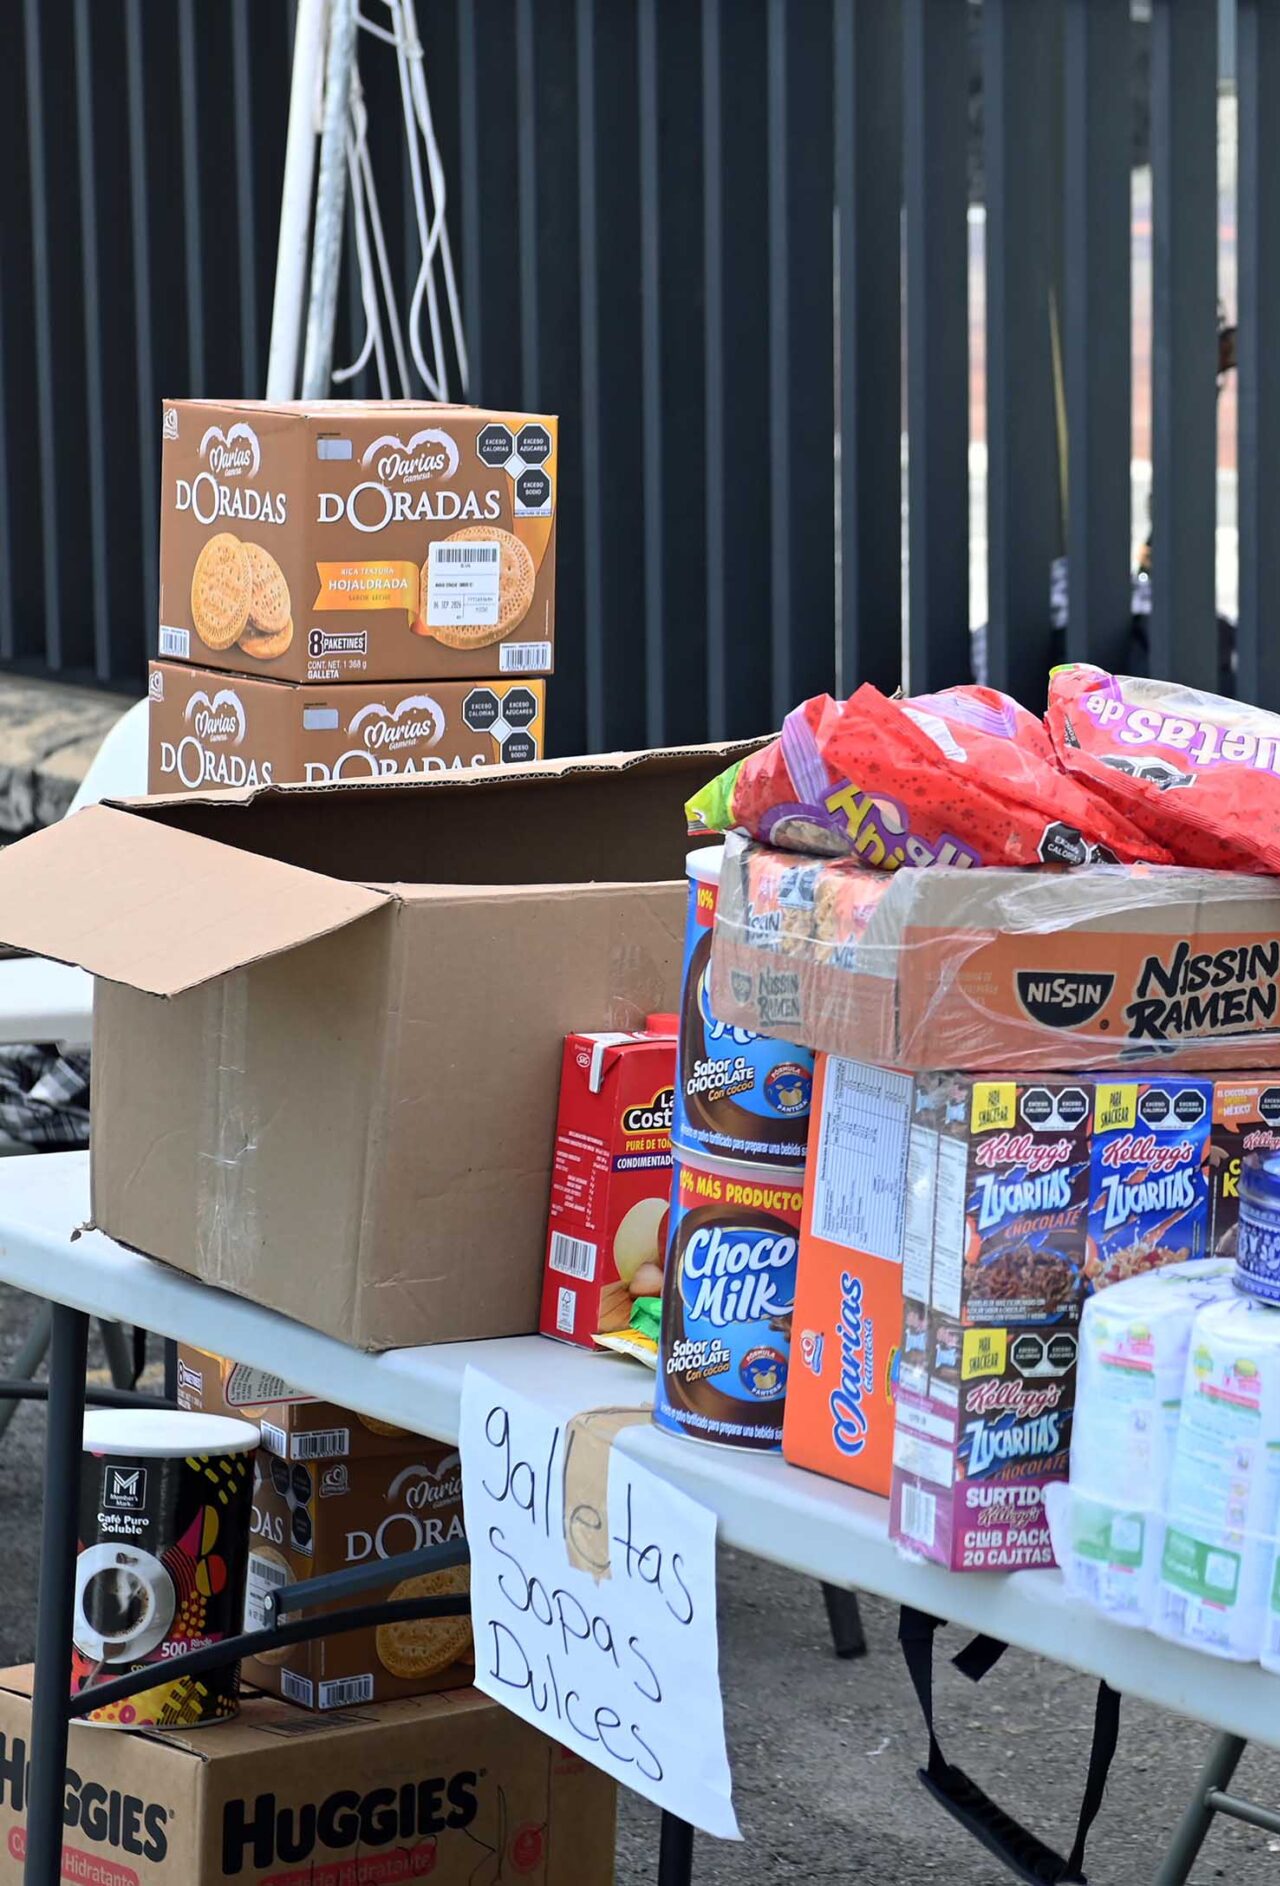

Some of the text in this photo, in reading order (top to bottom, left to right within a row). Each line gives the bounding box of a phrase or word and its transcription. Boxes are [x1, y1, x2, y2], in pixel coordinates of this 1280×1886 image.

[377, 453, 445, 482] Marias
[175, 471, 287, 525] DORADAS
[316, 481, 501, 533] DORADAS
[328, 579, 409, 591] HOJALDRADA
[309, 630, 365, 656] 8 PAKETINES
[307, 670, 340, 679] GALLETA
[1086, 693, 1125, 725] de
[364, 719, 431, 747] Marias
[160, 736, 273, 789] DORADAS
[1137, 940, 1280, 999] NISSIN
[1027, 979, 1103, 1008] NISSIN
[1125, 983, 1279, 1052] RAMEN
[687, 1067, 755, 1095] CHOCOLATE
[693, 1056, 746, 1078] Sabor a
[707, 1080, 754, 1102] Con cocoa
[1100, 1107, 1129, 1129] SNACKEAR
[625, 1138, 656, 1152] PURÉ DE
[974, 1132, 1073, 1172] Kellogg's
[1101, 1132, 1193, 1172] Kellogg's
[696, 1174, 804, 1212] MÁS PRODUCTO
[975, 1166, 1072, 1232] ZUCARITAS
[1101, 1166, 1195, 1232] ZUCARITAS
[1003, 1210, 1082, 1236] CHOCOLATE
[684, 1226, 797, 1280] Choco
[688, 1272, 796, 1328] Milk
[666, 1350, 731, 1375] CHOCOLATE
[672, 1338, 722, 1358] Sabor a
[685, 1363, 731, 1383] Con cocoa
[829, 1271, 869, 1457] Marias
[965, 1378, 1061, 1416] Kellogg's
[965, 1412, 1060, 1476] ZUCARITAS
[97, 1512, 150, 1527] Café Puro
[100, 1522, 144, 1536] Soluble
[1006, 1529, 1050, 1547] PACK
[963, 1549, 1051, 1566] 20 CAJITAS
[161, 1642, 188, 1658] 500
[488, 1619, 663, 1783] Dulces
[222, 1771, 480, 1876] HUGGIES
